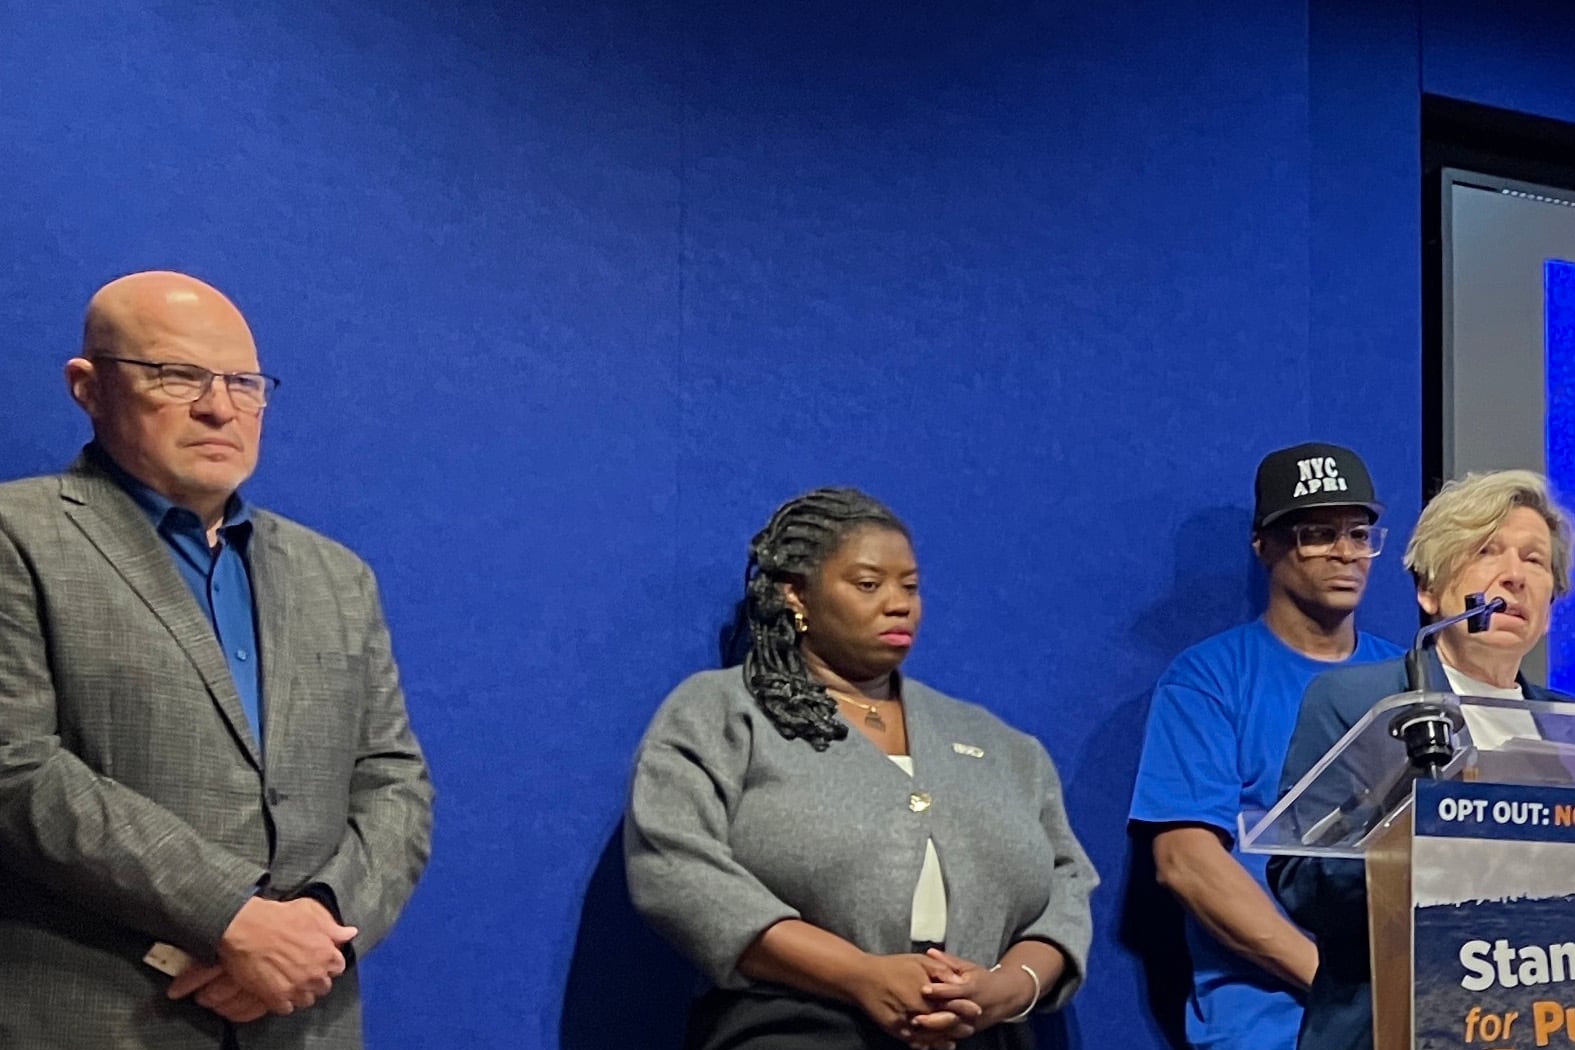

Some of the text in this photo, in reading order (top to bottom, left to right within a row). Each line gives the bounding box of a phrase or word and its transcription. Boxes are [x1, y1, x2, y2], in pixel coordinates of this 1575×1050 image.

[1297, 456, 1338, 481] NYC
[1437, 797, 1487, 823] OPT
[1492, 800, 1550, 826] OUT:
[1464, 1006, 1518, 1044] for
